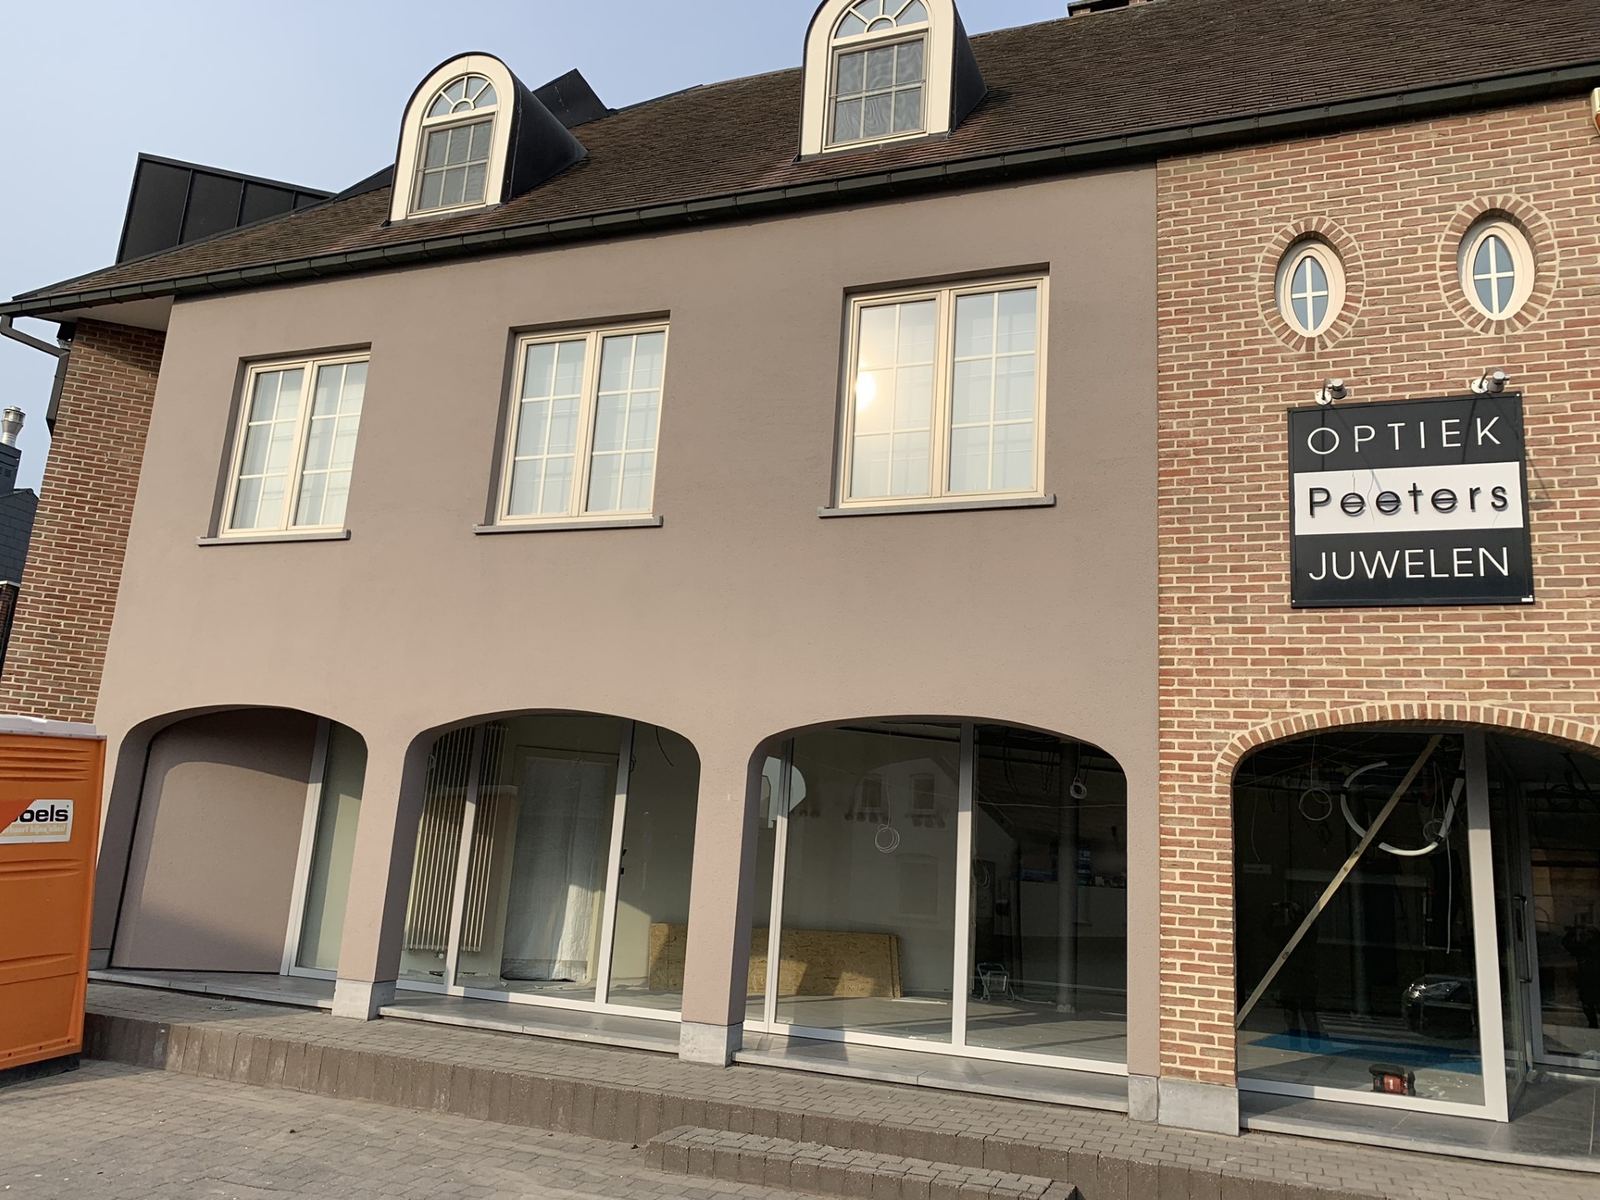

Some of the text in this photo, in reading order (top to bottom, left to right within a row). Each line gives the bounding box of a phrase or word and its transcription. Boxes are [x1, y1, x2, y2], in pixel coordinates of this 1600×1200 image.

[1307, 416, 1501, 455] OPTIEK
[1308, 482, 1508, 518] Peeters
[1308, 546, 1509, 580] JUWELEN
[14, 804, 69, 823] oels
